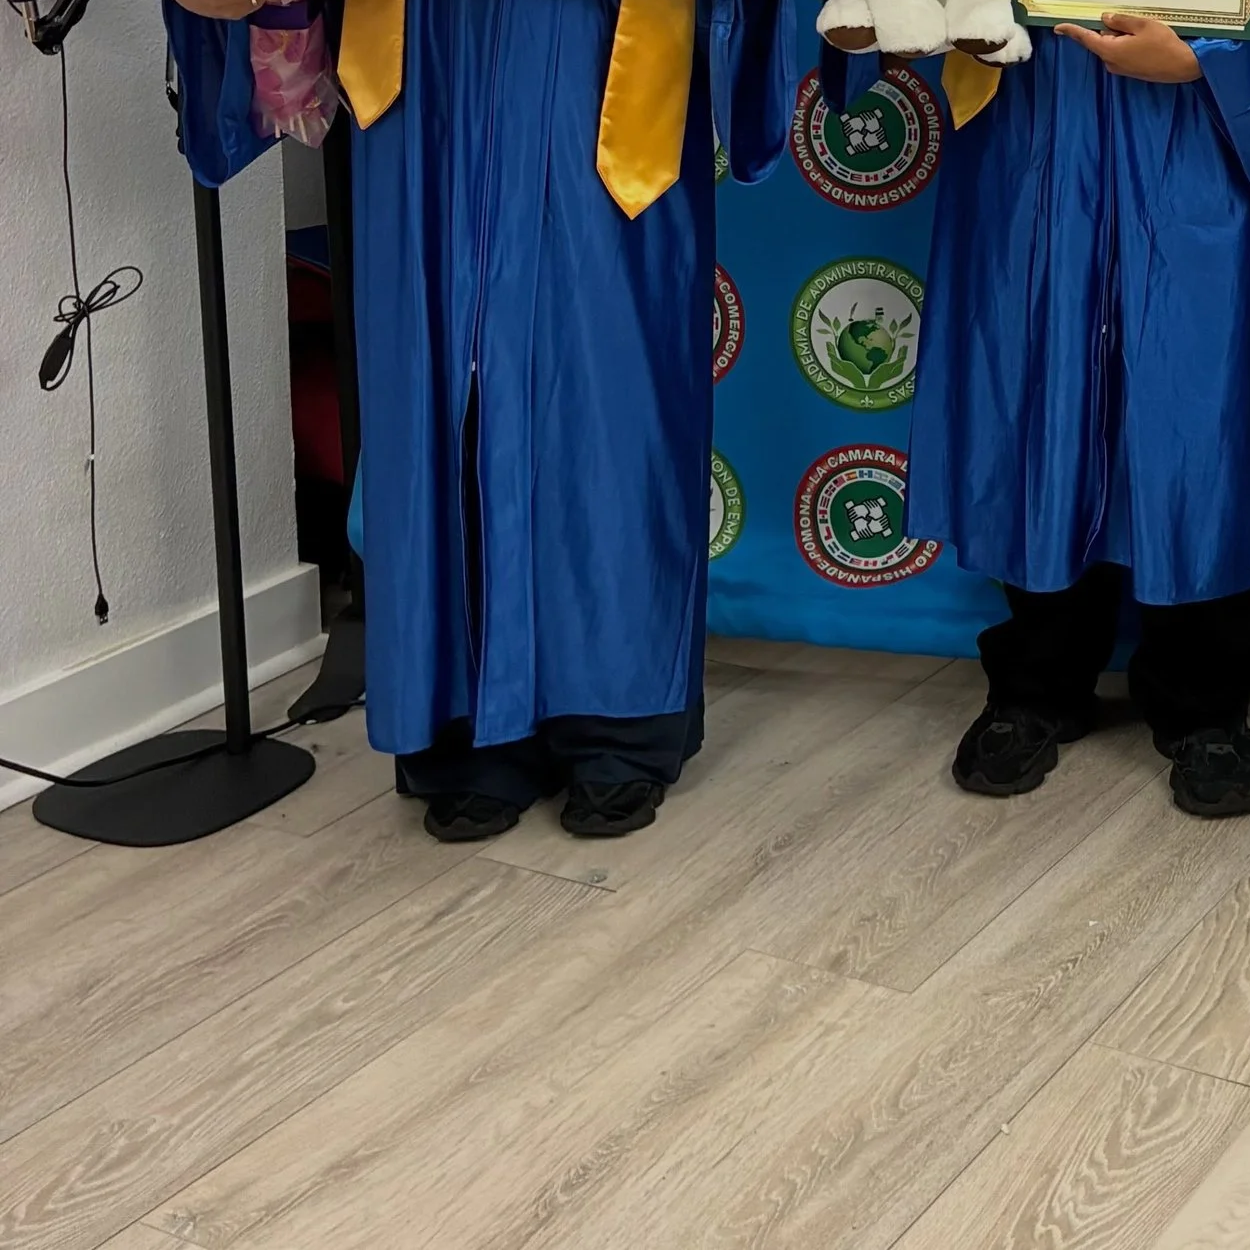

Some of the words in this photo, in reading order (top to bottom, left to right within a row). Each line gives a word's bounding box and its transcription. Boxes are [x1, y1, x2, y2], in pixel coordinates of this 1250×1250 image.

[898, 69, 919, 90] DE
[916, 93, 940, 180] COMERCIO
[717, 281, 740, 368] COMERCIO
[796, 300, 812, 322] DE
[794, 328, 845, 398] ACADEMIA
[813, 466, 827, 485] LA
[828, 449, 896, 467] CAMARA
